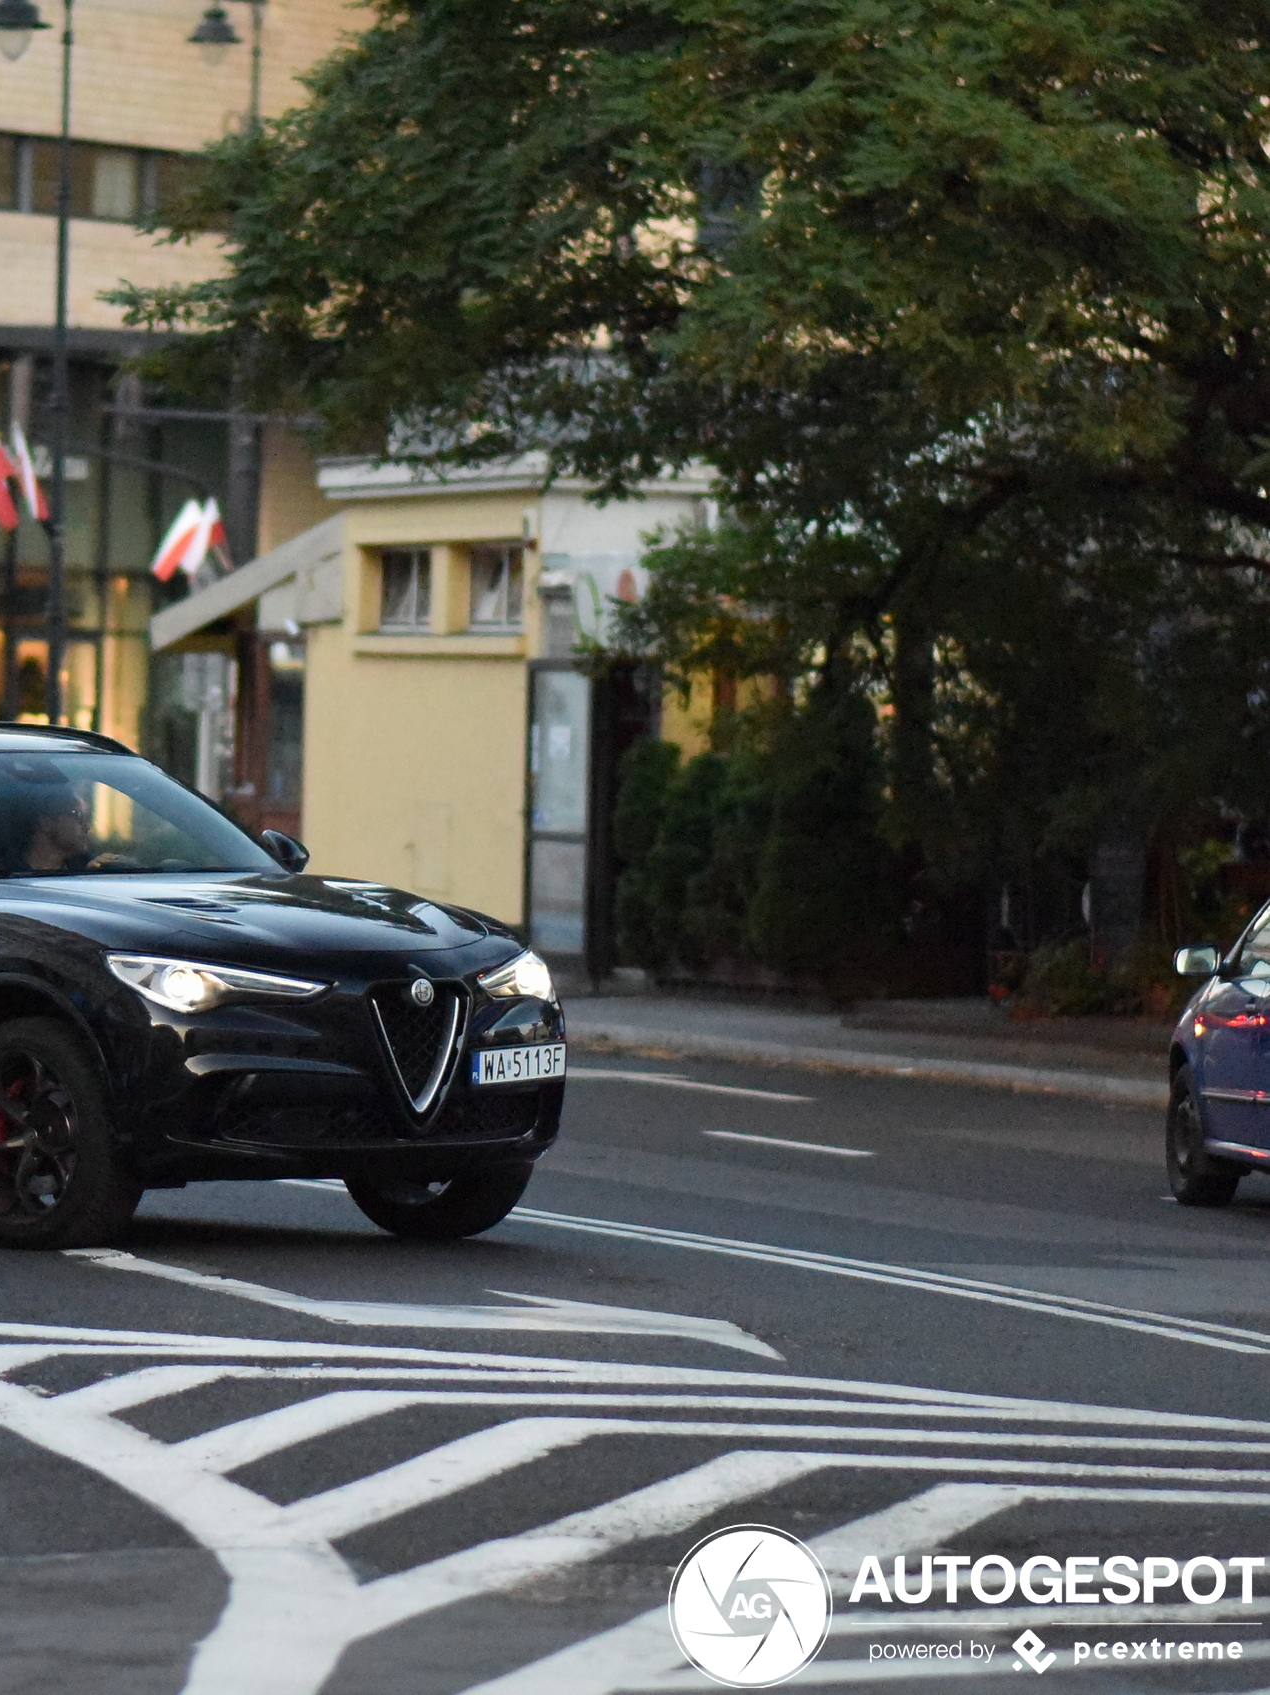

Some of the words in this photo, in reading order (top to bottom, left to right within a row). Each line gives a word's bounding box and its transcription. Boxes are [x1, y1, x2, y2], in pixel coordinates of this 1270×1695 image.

[484, 1053, 506, 1081] WA
[513, 1046, 563, 1078] 5113F
[472, 1071, 479, 1080] PL
